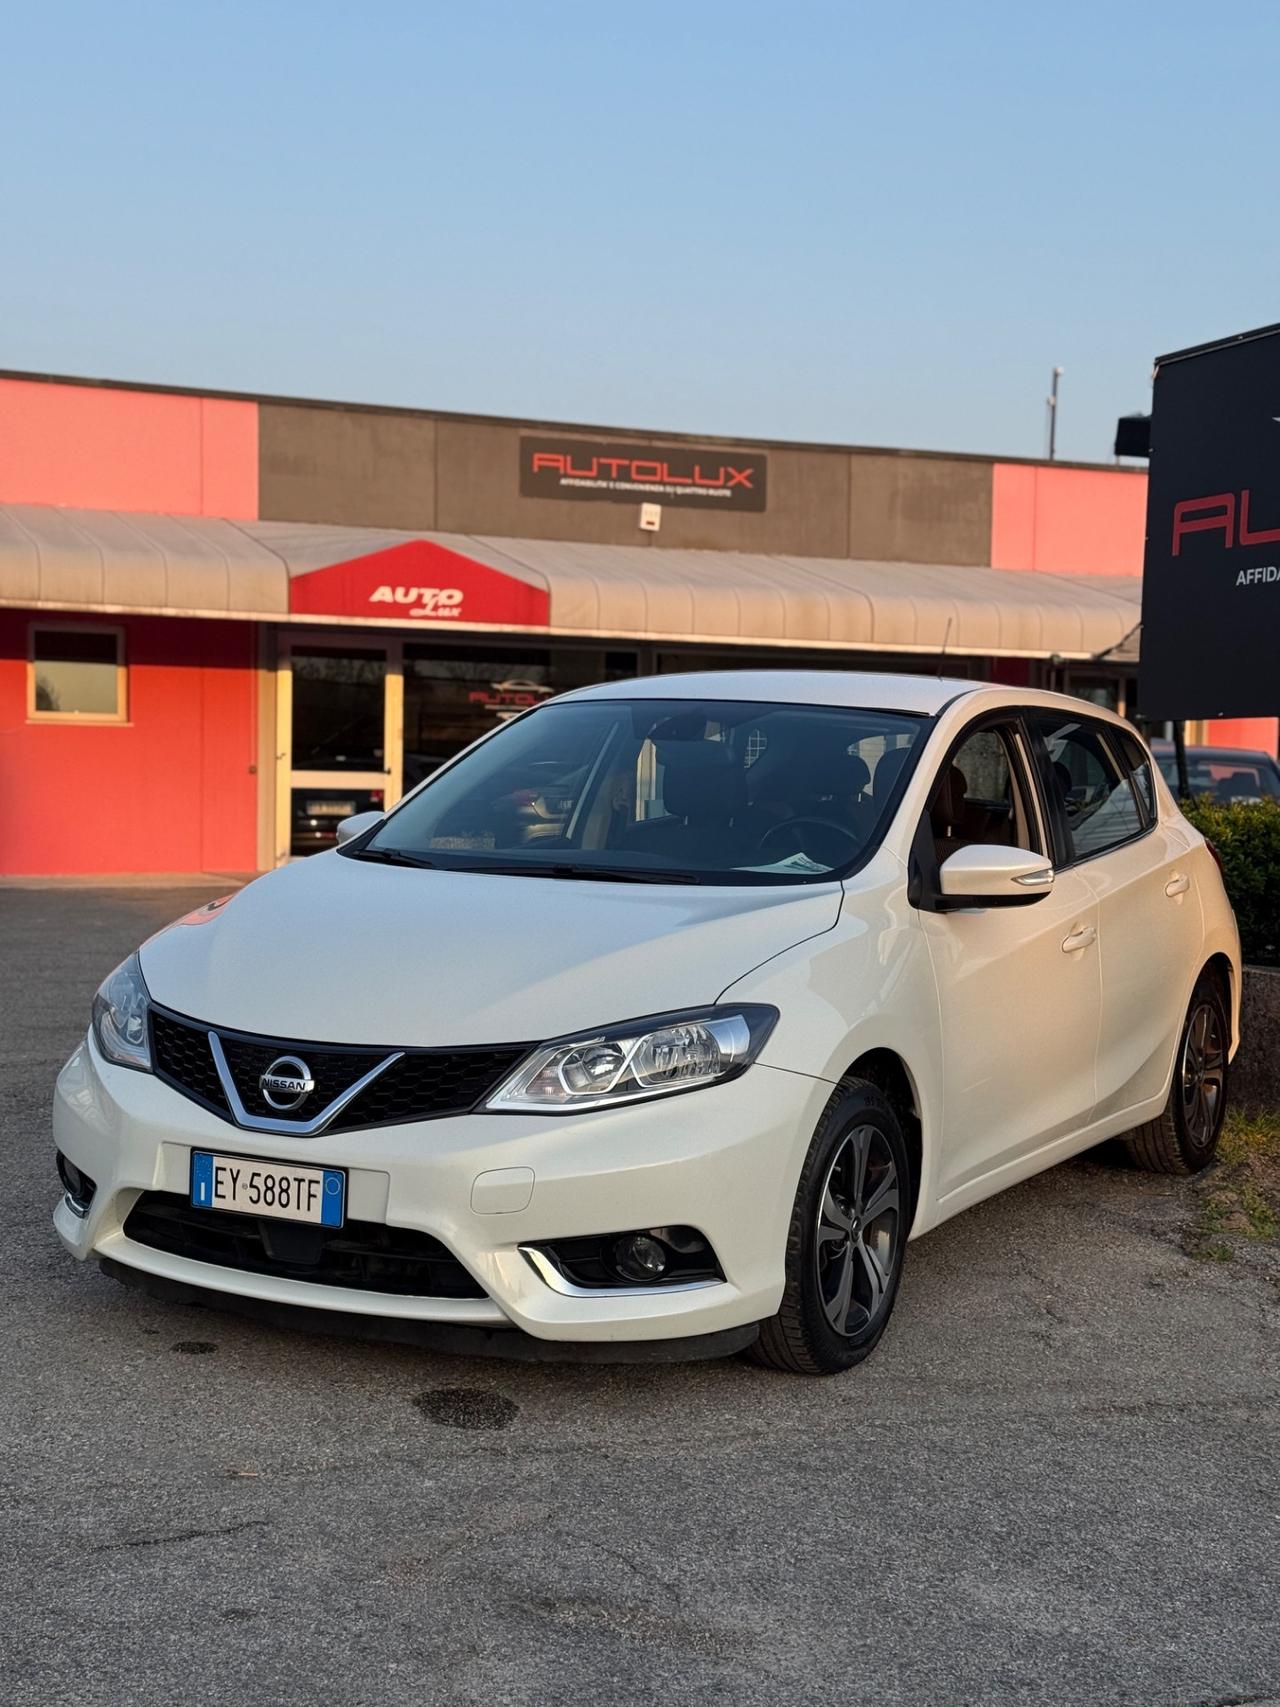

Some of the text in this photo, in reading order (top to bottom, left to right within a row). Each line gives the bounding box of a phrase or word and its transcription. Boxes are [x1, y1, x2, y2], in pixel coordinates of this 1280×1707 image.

[532, 452, 754, 489] AUTOLUX
[368, 585, 464, 606] AUTO
[263, 1078, 306, 1091] NISSAN
[214, 1166, 321, 1212] EY 588TF
